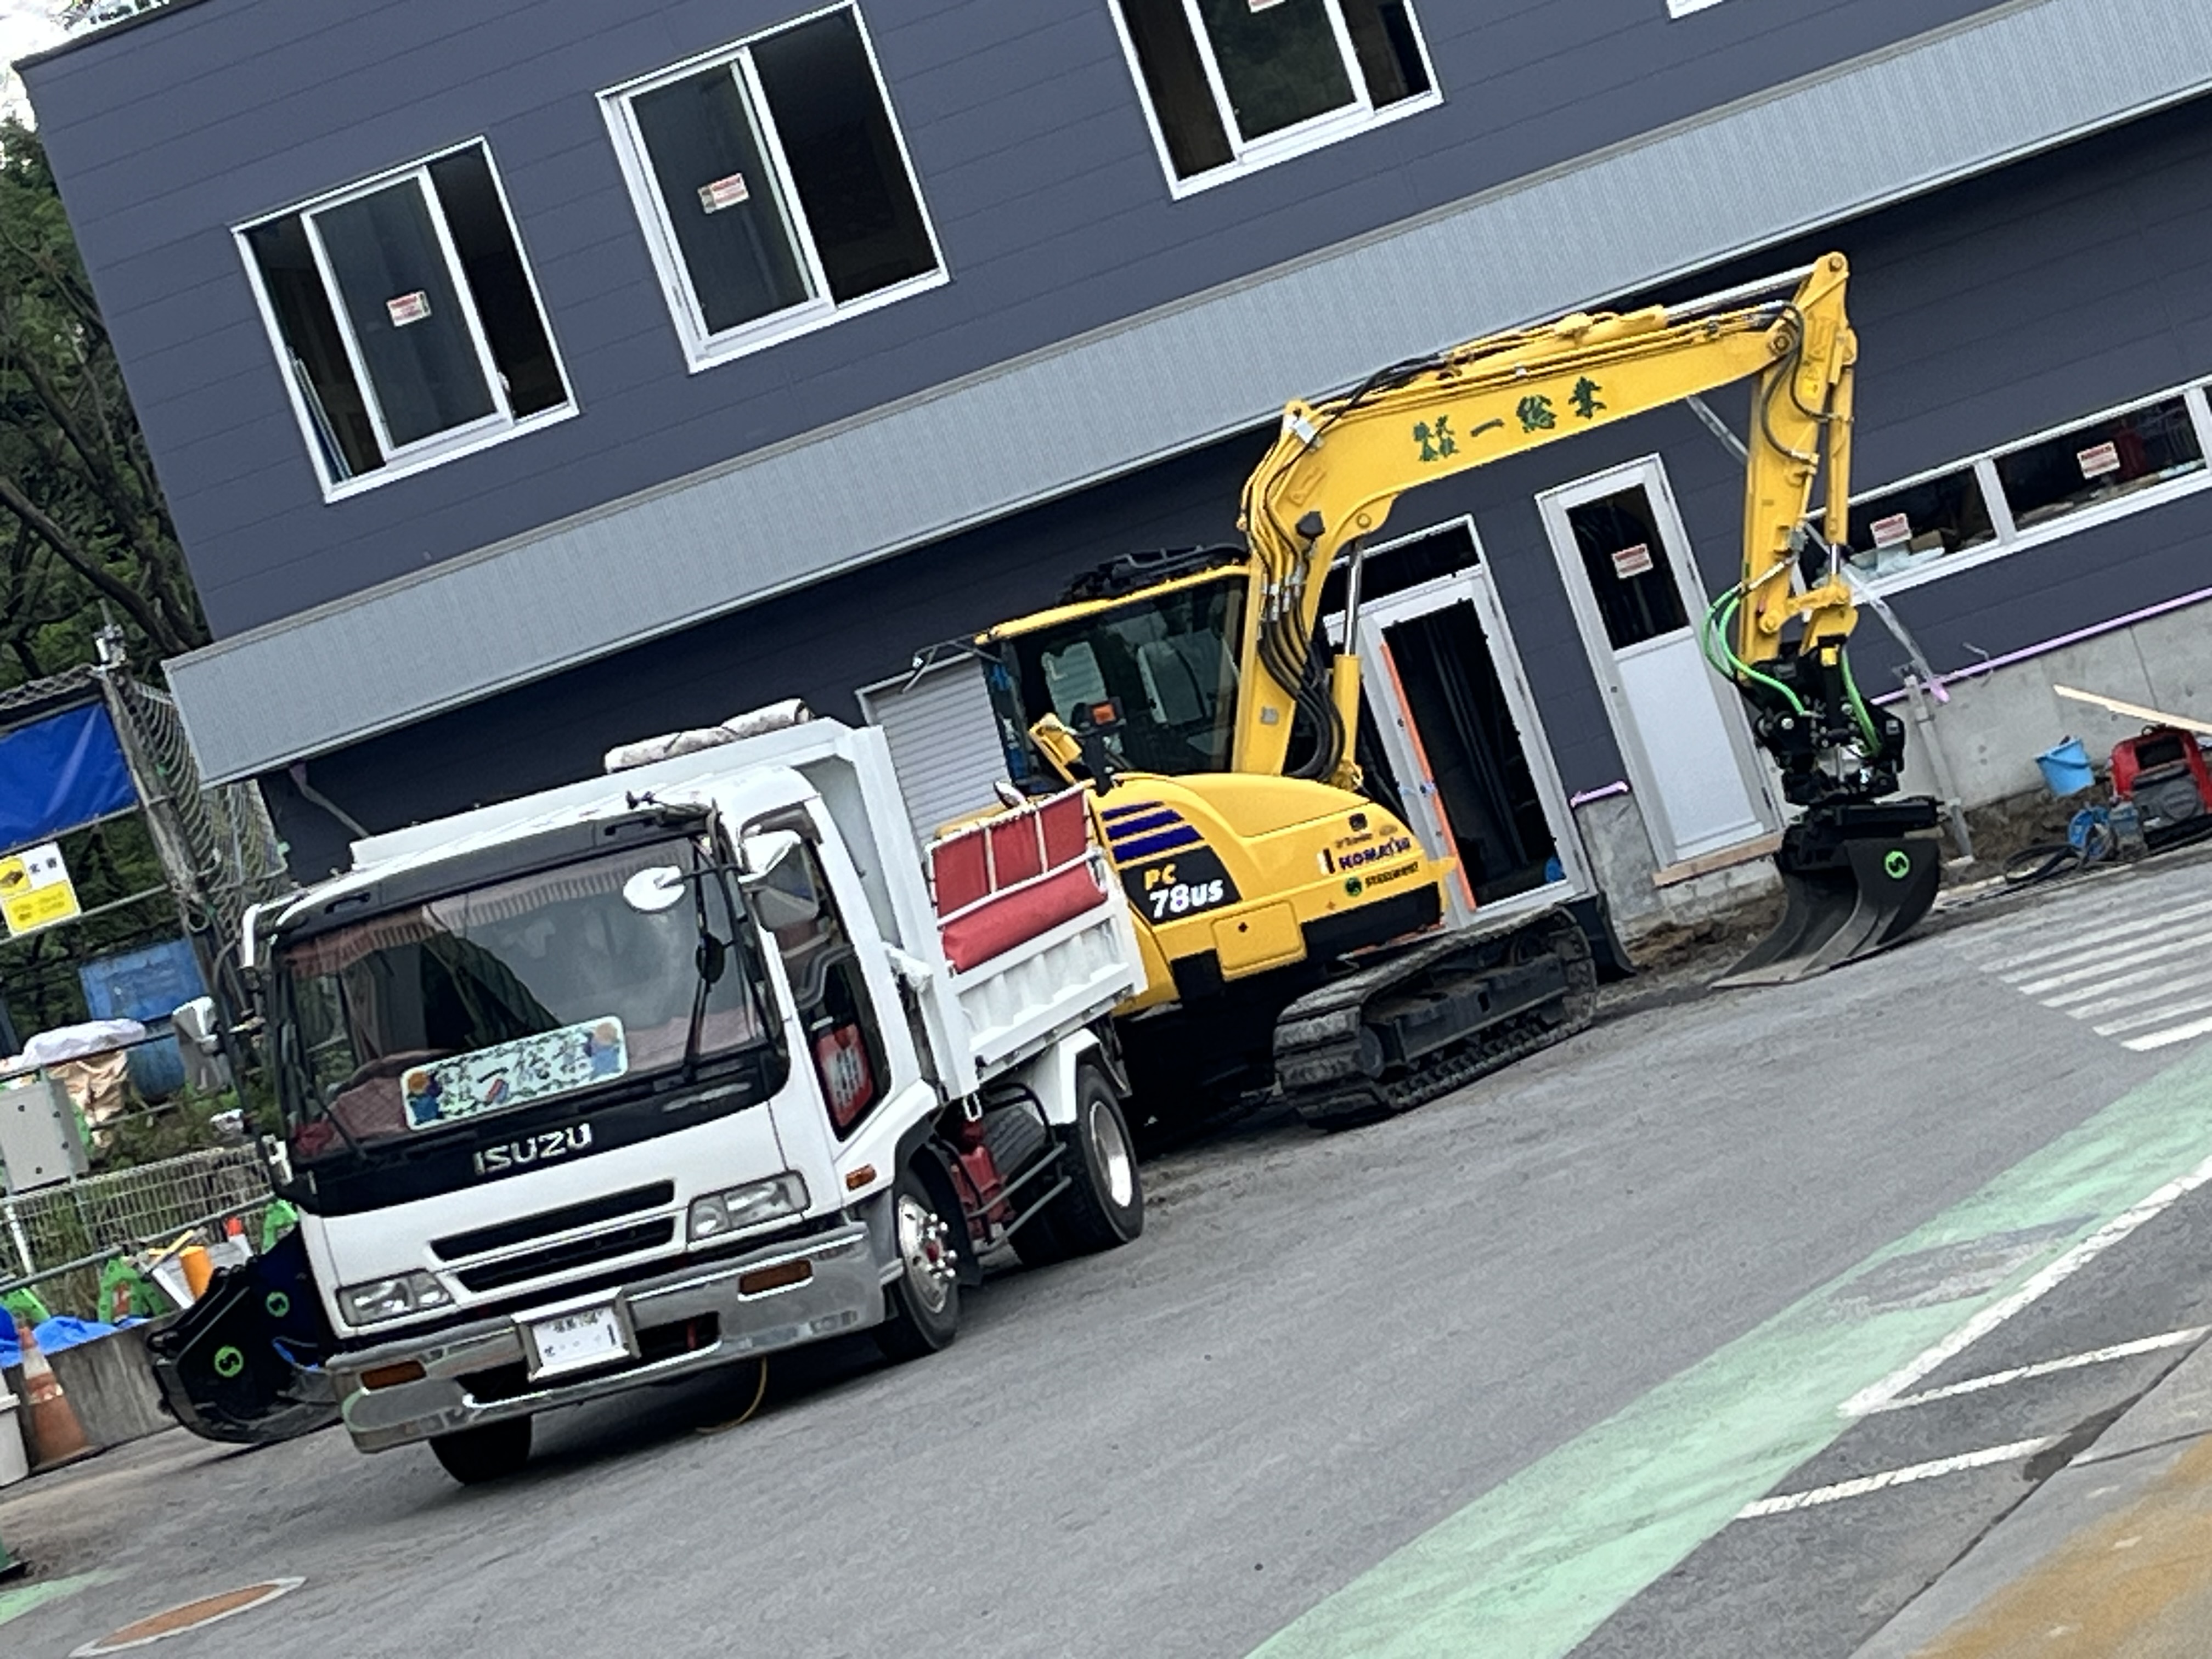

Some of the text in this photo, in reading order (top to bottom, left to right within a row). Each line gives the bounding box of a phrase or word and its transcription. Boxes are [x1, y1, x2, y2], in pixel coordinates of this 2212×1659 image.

[1339, 837, 1410, 870] KOMATSU
[1144, 864, 1176, 890] PC
[474, 1122, 592, 1175] ISUZU
